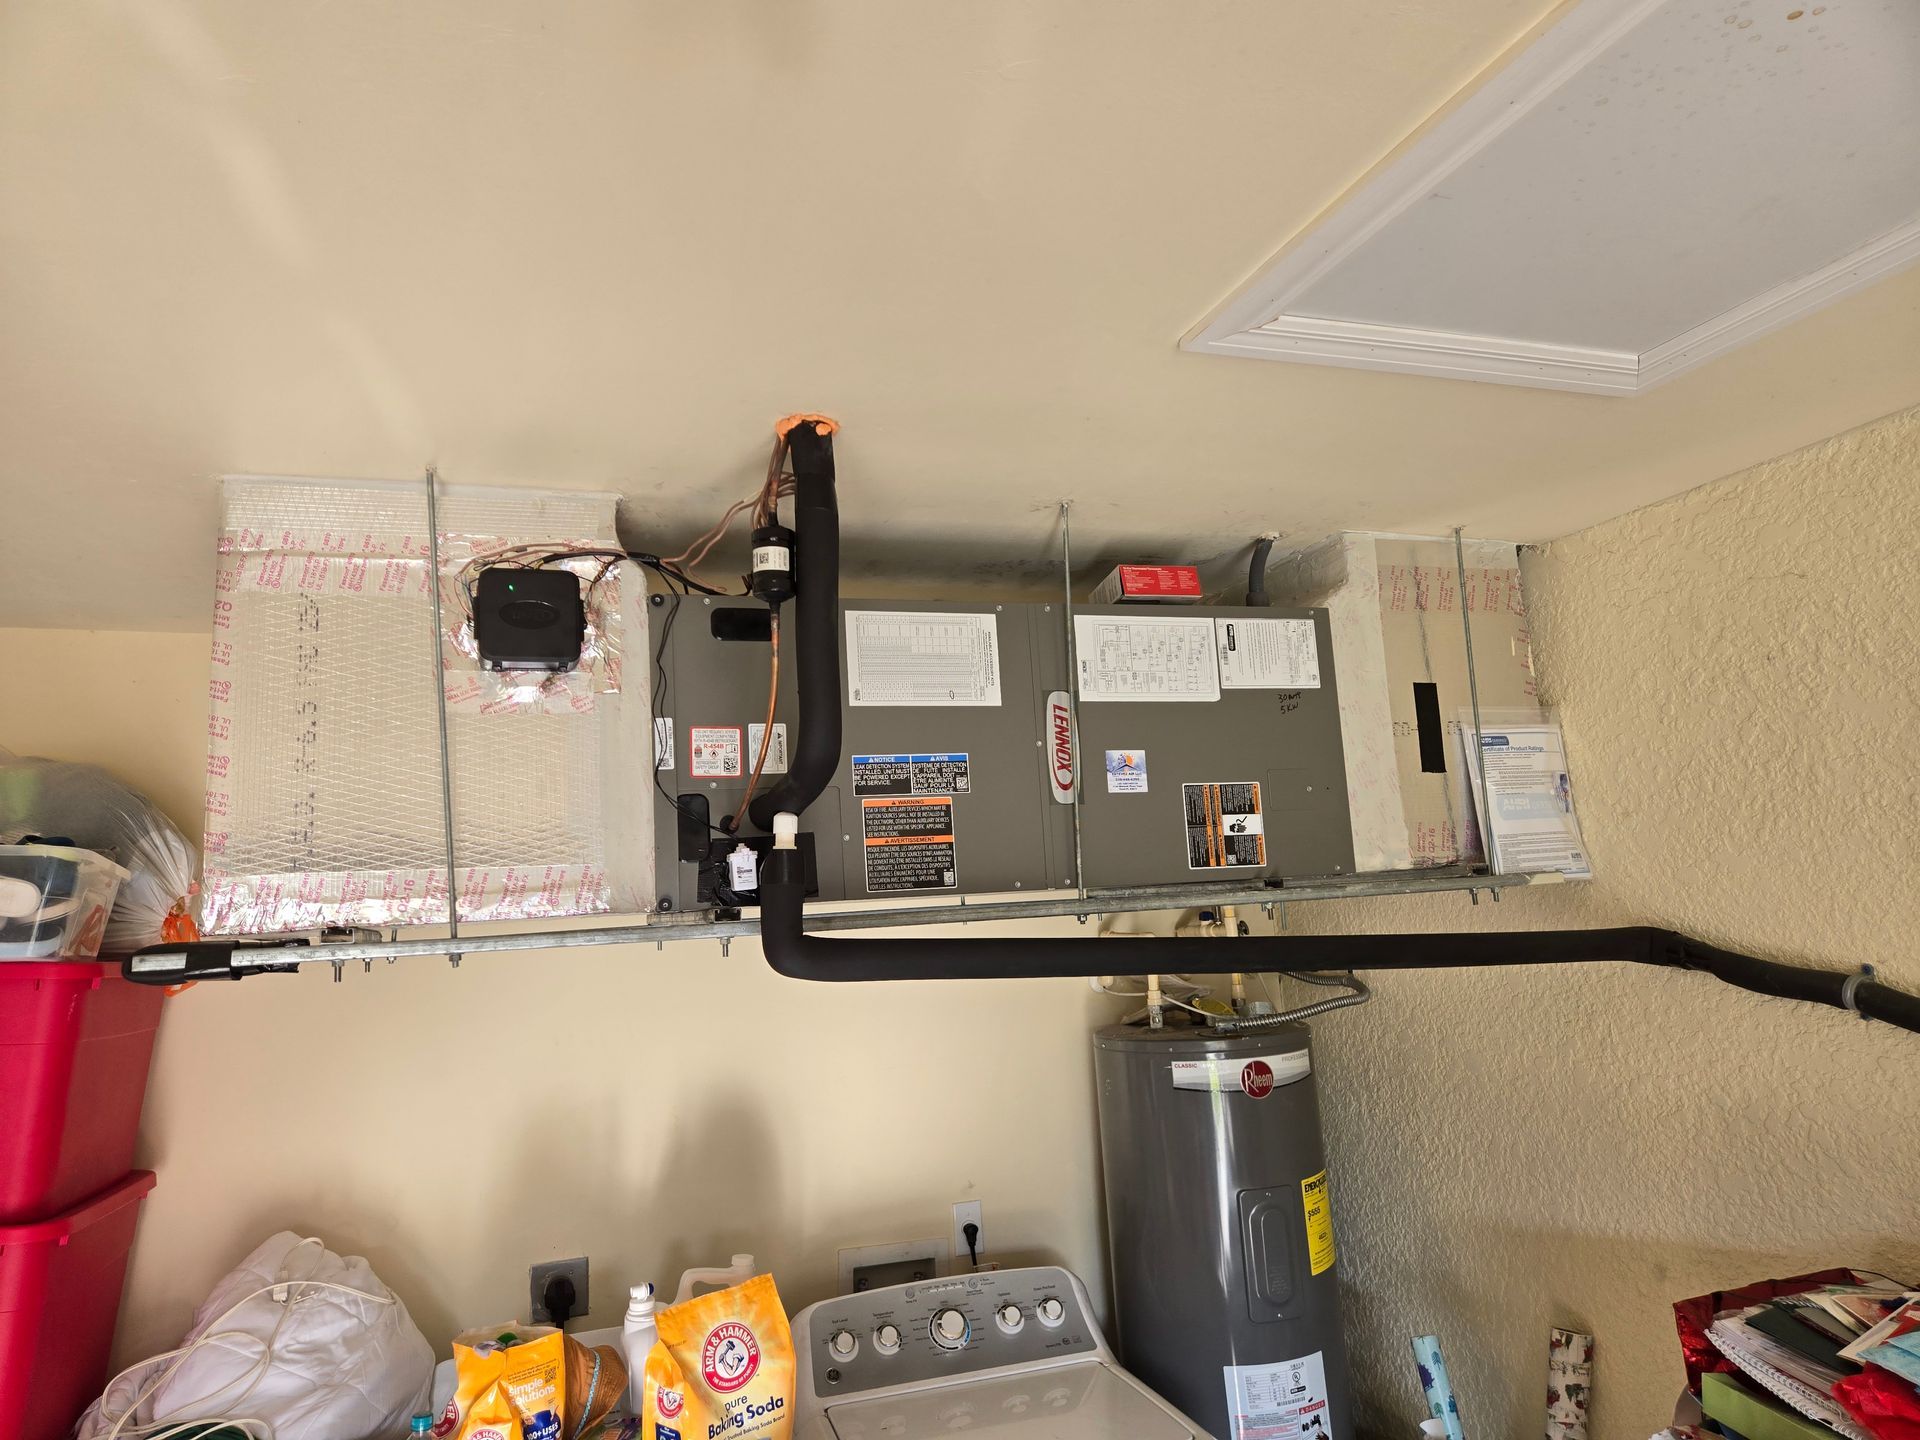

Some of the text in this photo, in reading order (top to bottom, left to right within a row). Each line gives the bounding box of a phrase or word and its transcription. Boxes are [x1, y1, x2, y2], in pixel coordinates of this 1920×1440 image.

[1053, 704, 1072, 774] LENNOX
[1244, 1062, 1272, 1092] Rheem
[705, 1327, 757, 1372] ARM & HAMMER
[744, 1364, 754, 1380] PURITY
[508, 1378, 543, 1396] simple
[512, 1384, 555, 1406] solutions
[724, 1395, 748, 1412] pure
[542, 1422, 558, 1436] USES
[708, 1396, 783, 1439] Baking Soda
[727, 1414, 785, 1440] Trusted Baking Soda Brand
